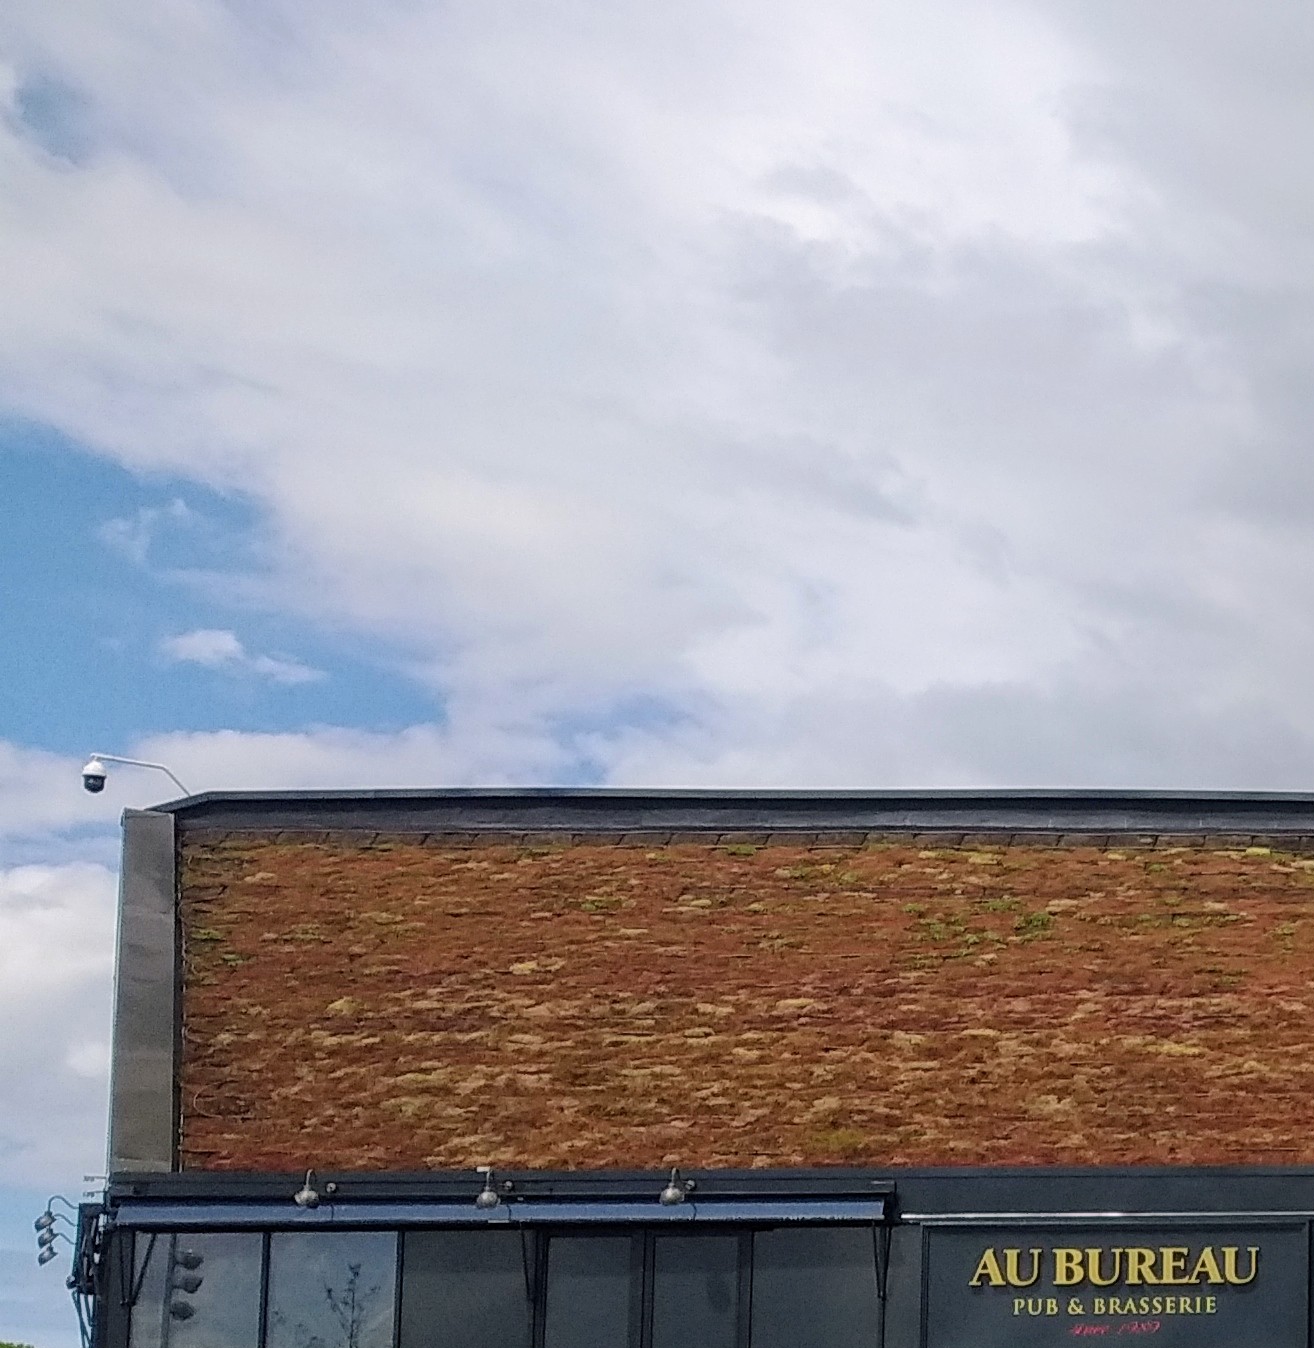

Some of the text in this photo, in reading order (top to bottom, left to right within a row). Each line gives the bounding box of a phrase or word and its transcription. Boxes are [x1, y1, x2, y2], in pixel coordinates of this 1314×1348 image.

[968, 1246, 1260, 1287] AU BUREAU
[1013, 1296, 1218, 1315] PUB & BRASSERIE
